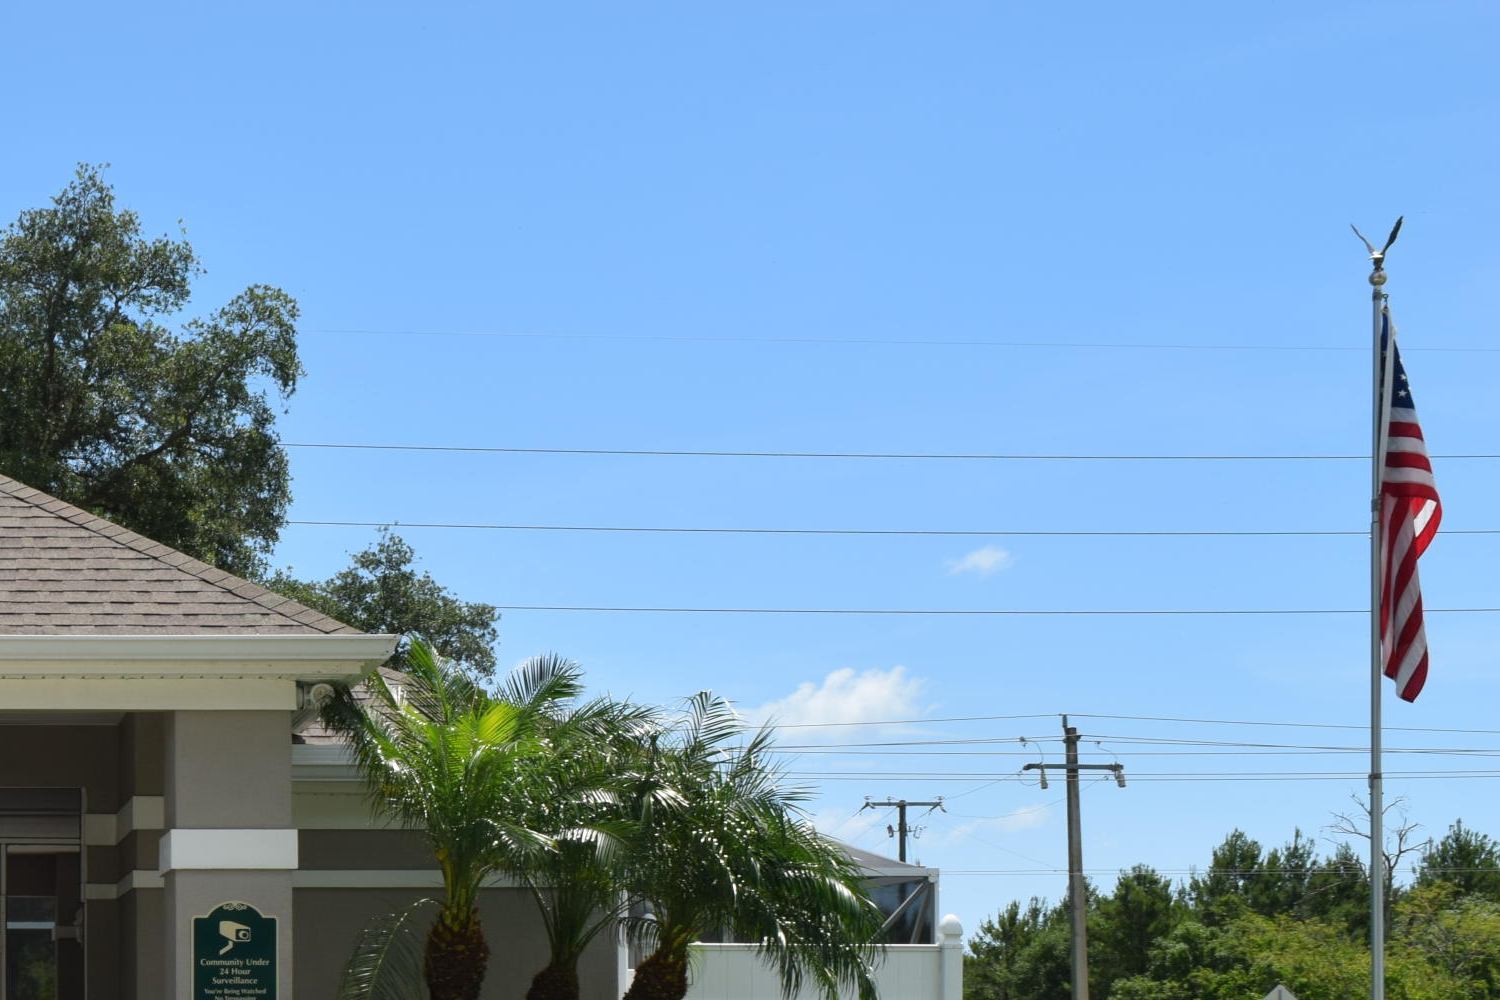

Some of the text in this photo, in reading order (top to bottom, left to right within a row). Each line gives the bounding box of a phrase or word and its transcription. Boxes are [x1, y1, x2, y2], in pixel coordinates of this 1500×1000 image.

[200, 958, 270, 967] Community Under
[219, 967, 252, 975] 24 Hour
[212, 976, 259, 985] Surveillance
